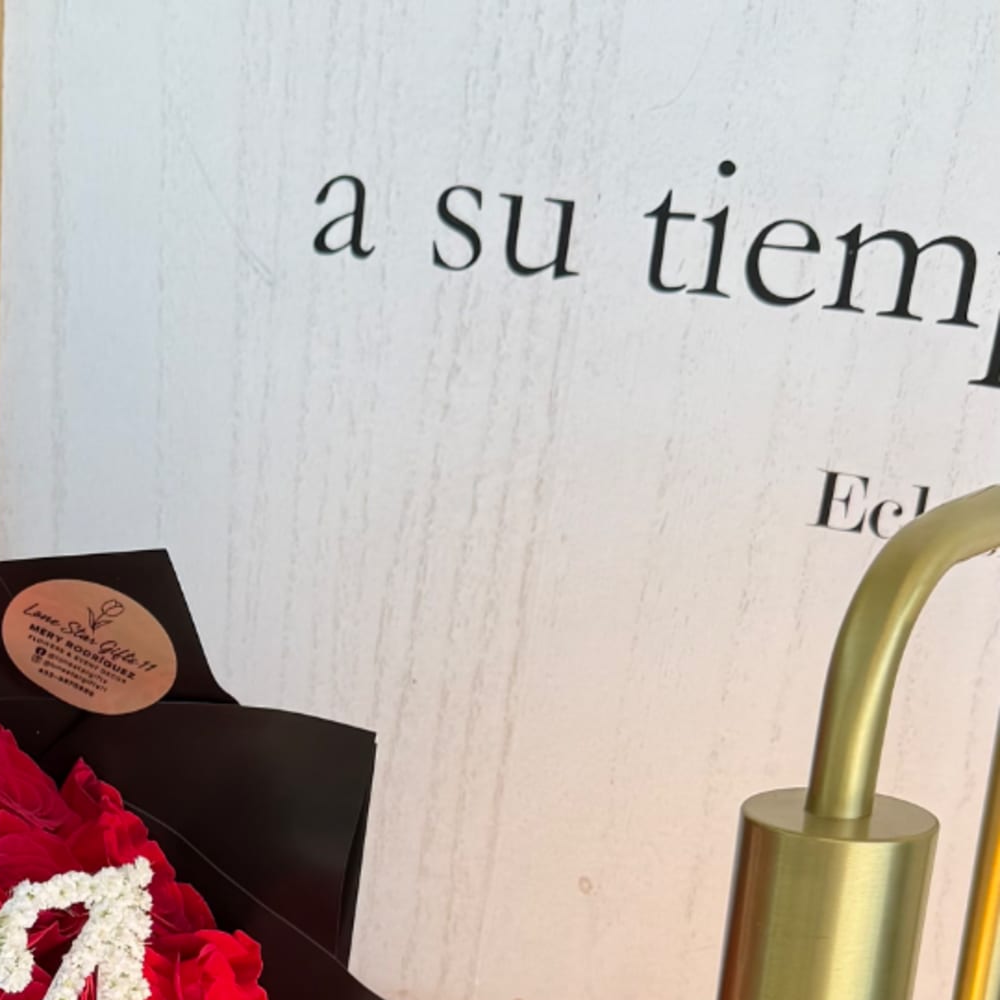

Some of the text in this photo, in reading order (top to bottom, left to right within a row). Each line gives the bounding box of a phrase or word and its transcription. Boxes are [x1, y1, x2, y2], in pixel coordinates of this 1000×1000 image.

[313, 174, 375, 259] a
[432, 184, 579, 280] su
[23, 602, 61, 626] Lone
[60, 620, 97, 645] Star
[28, 623, 63, 643] MERY
